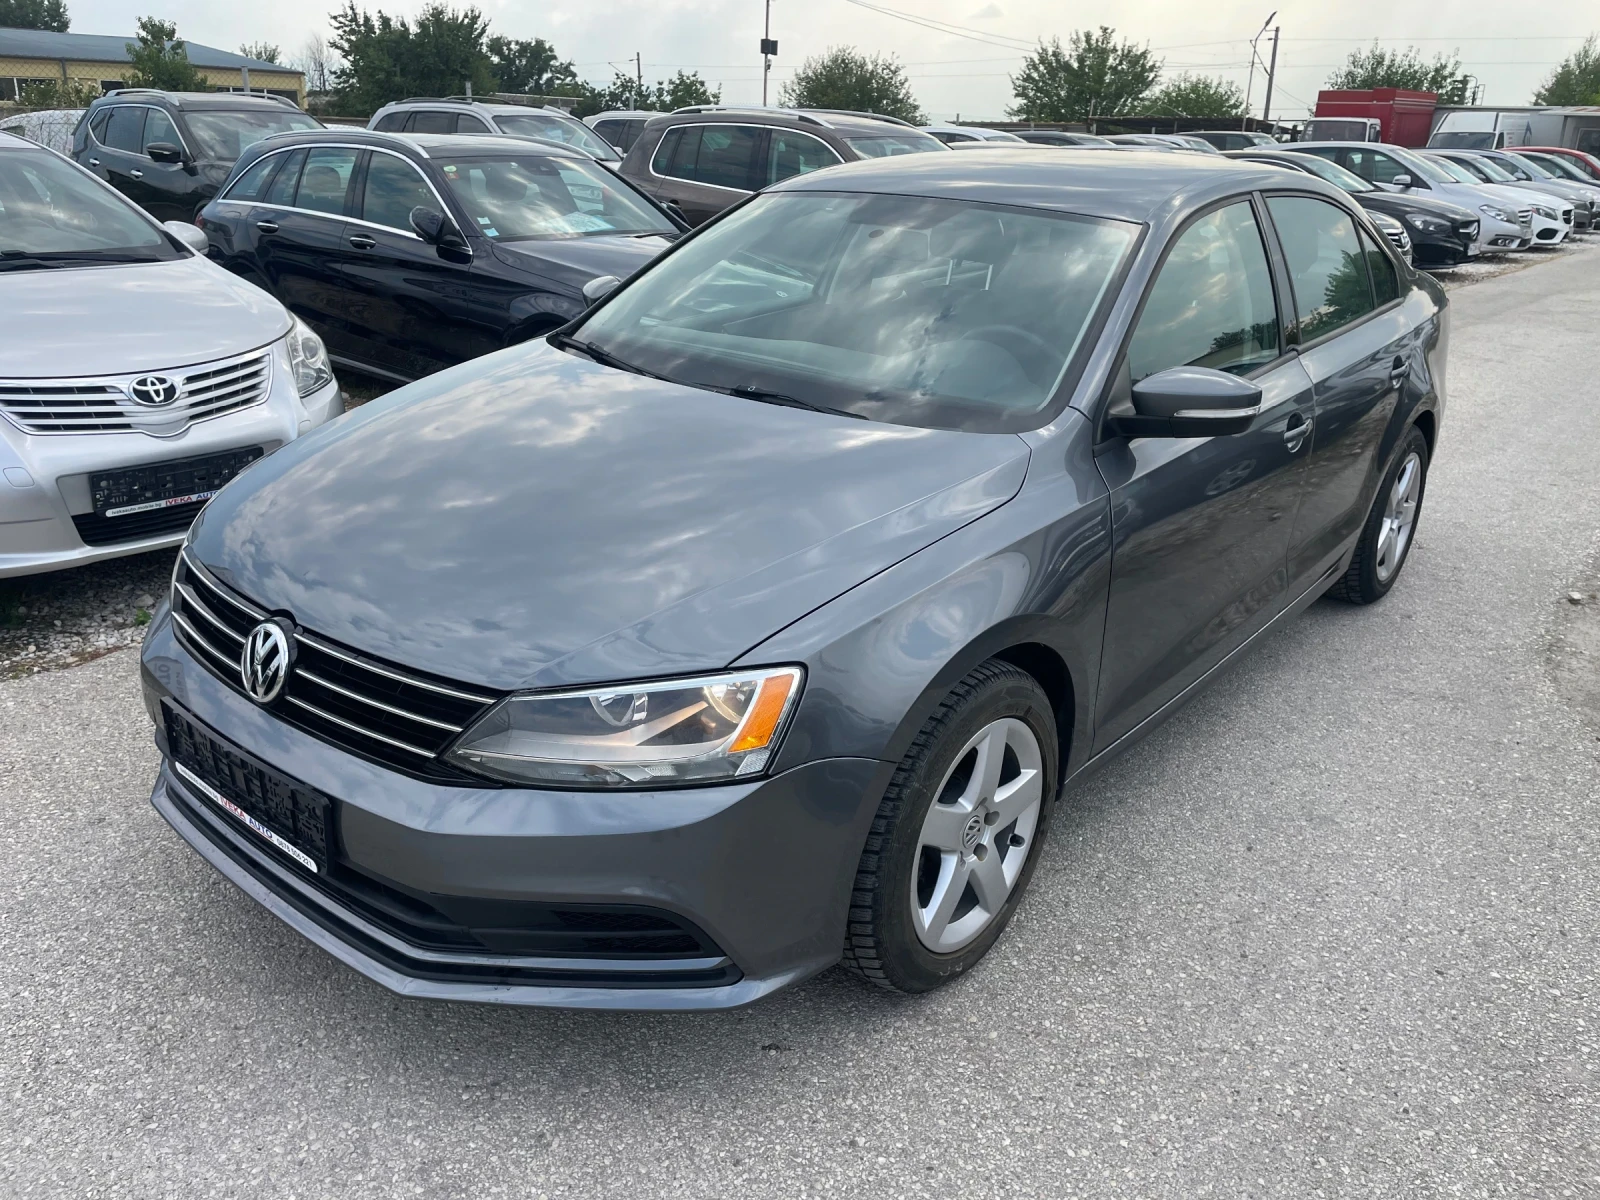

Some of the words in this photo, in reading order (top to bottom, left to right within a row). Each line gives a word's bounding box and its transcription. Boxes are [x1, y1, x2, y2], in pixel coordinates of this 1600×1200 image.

[165, 496, 192, 507] IVEKA
[220, 796, 246, 819] IVEKA
[249, 817, 273, 839] AUTO
